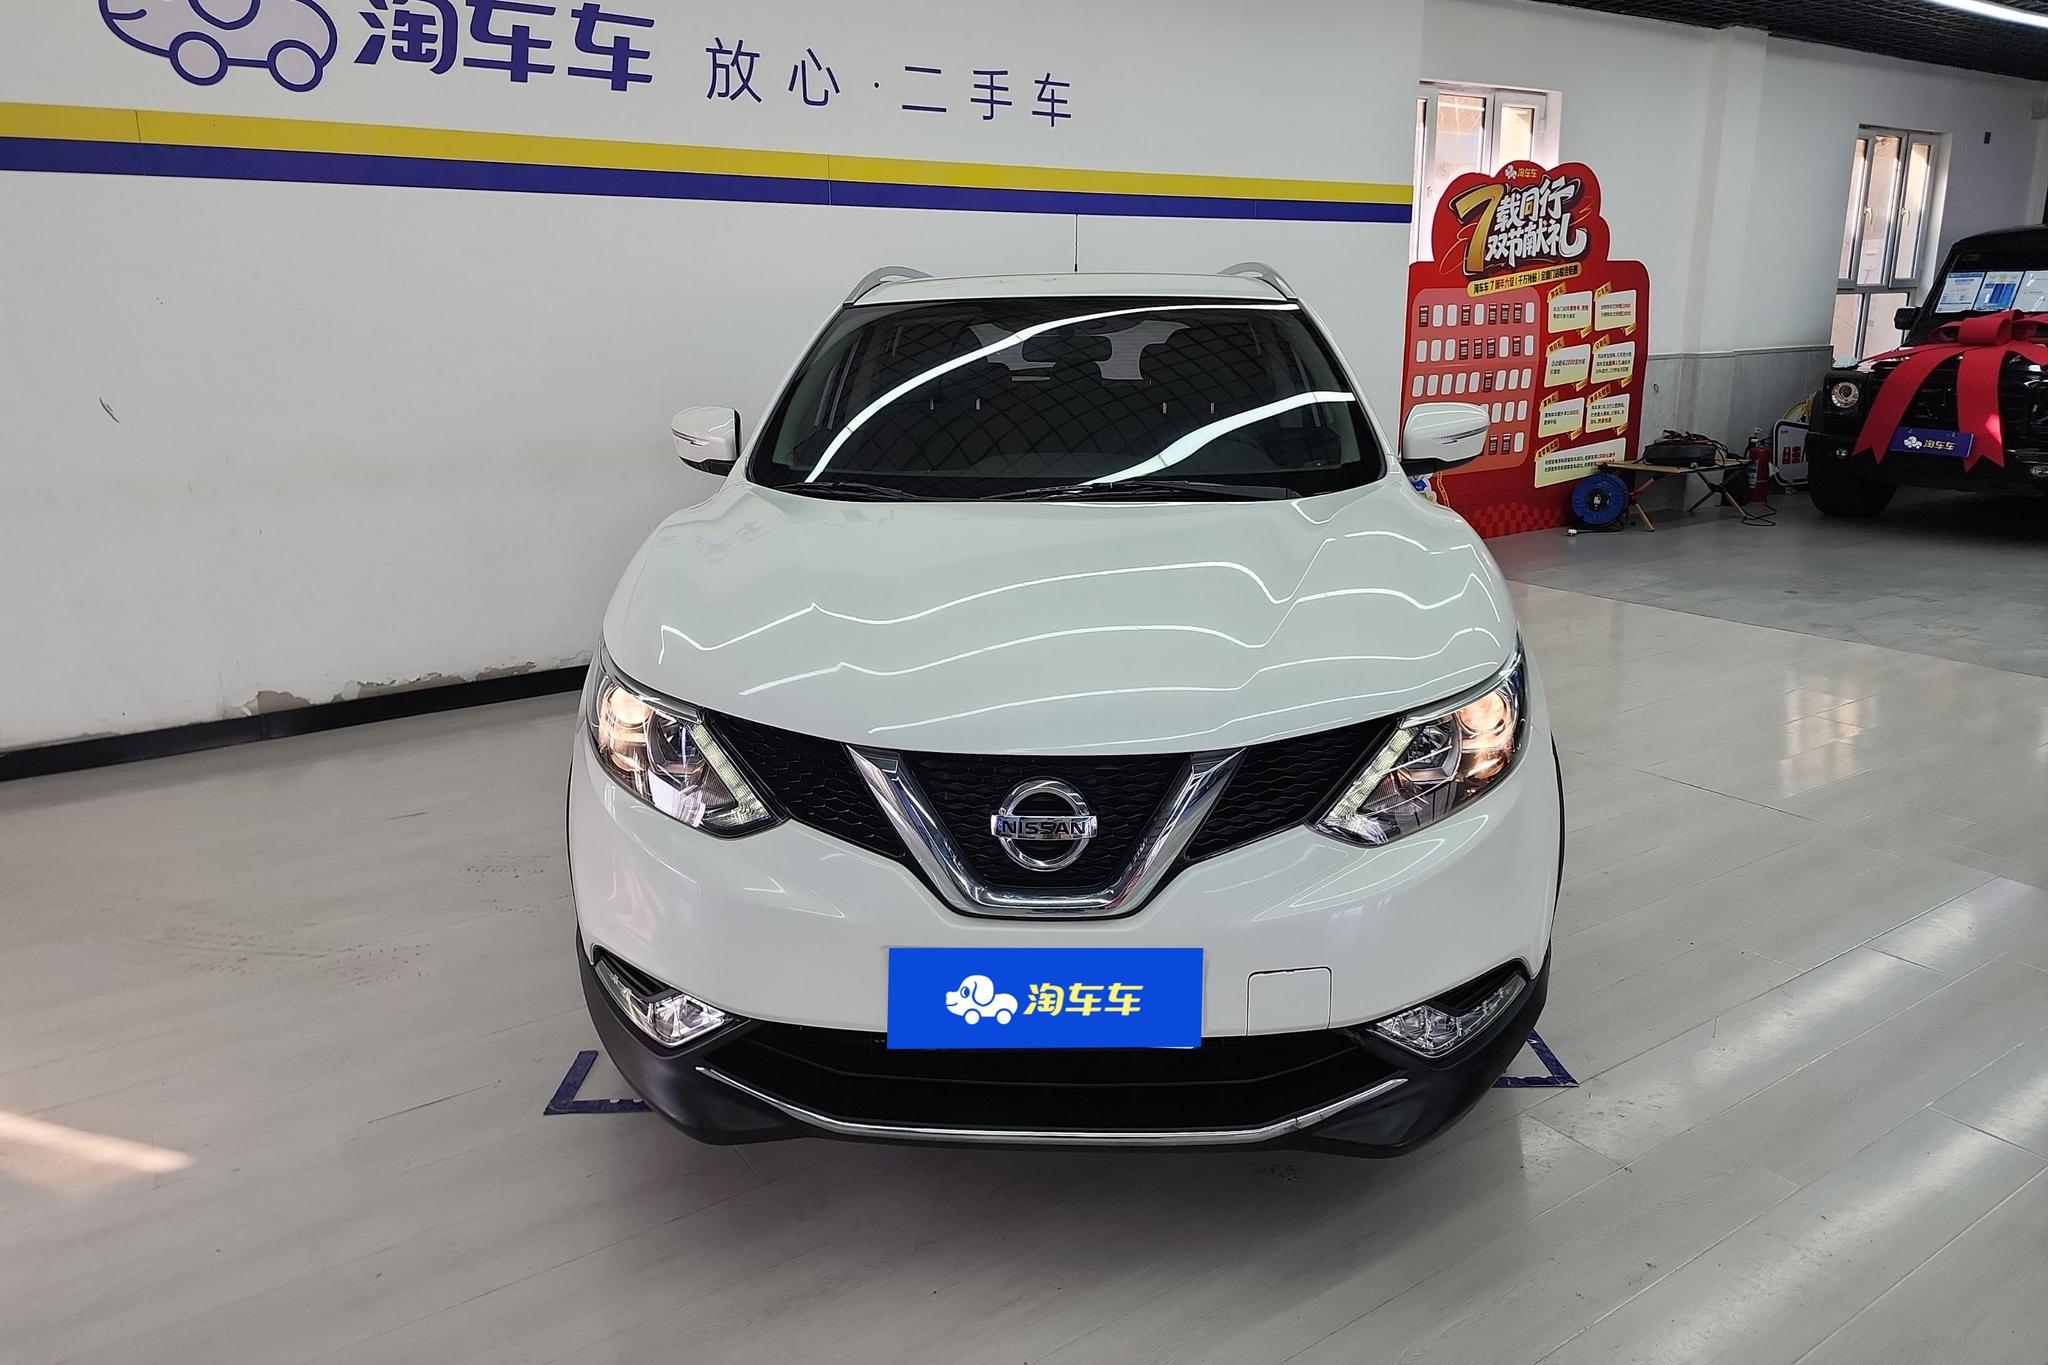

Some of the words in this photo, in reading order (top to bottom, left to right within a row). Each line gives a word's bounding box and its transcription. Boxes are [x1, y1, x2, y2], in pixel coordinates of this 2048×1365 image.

[353, 0, 655, 92] 淘车车
[1485, 212, 1587, 267] 双节献礼
[1923, 439, 1956, 451] 淘车车
[1001, 820, 1087, 835] NISSAN
